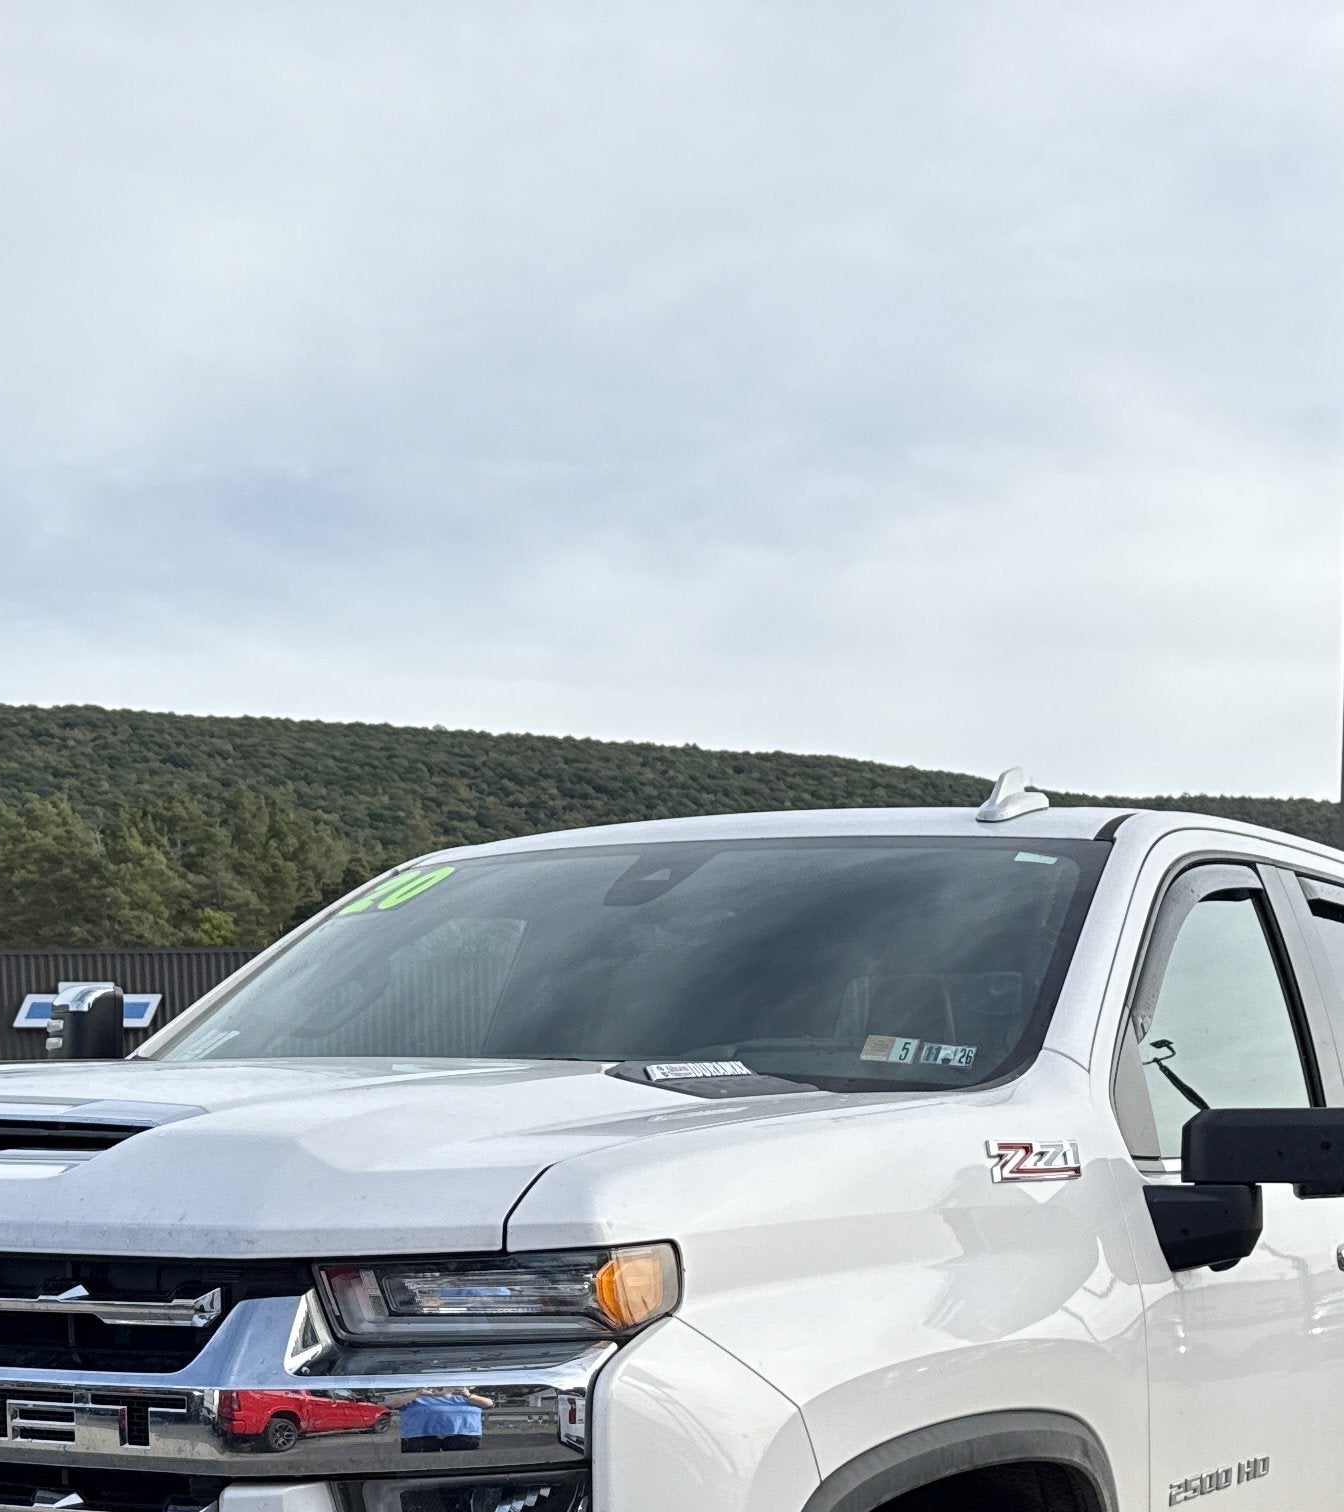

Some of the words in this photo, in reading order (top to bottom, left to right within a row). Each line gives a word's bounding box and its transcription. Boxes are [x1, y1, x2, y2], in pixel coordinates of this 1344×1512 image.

[898, 1041, 912, 1061] 5
[957, 1048, 974, 1065] 26
[984, 1140, 1082, 1183] Z71
[1168, 1466, 1232, 1507] 2500
[1237, 1456, 1270, 1485] HD
